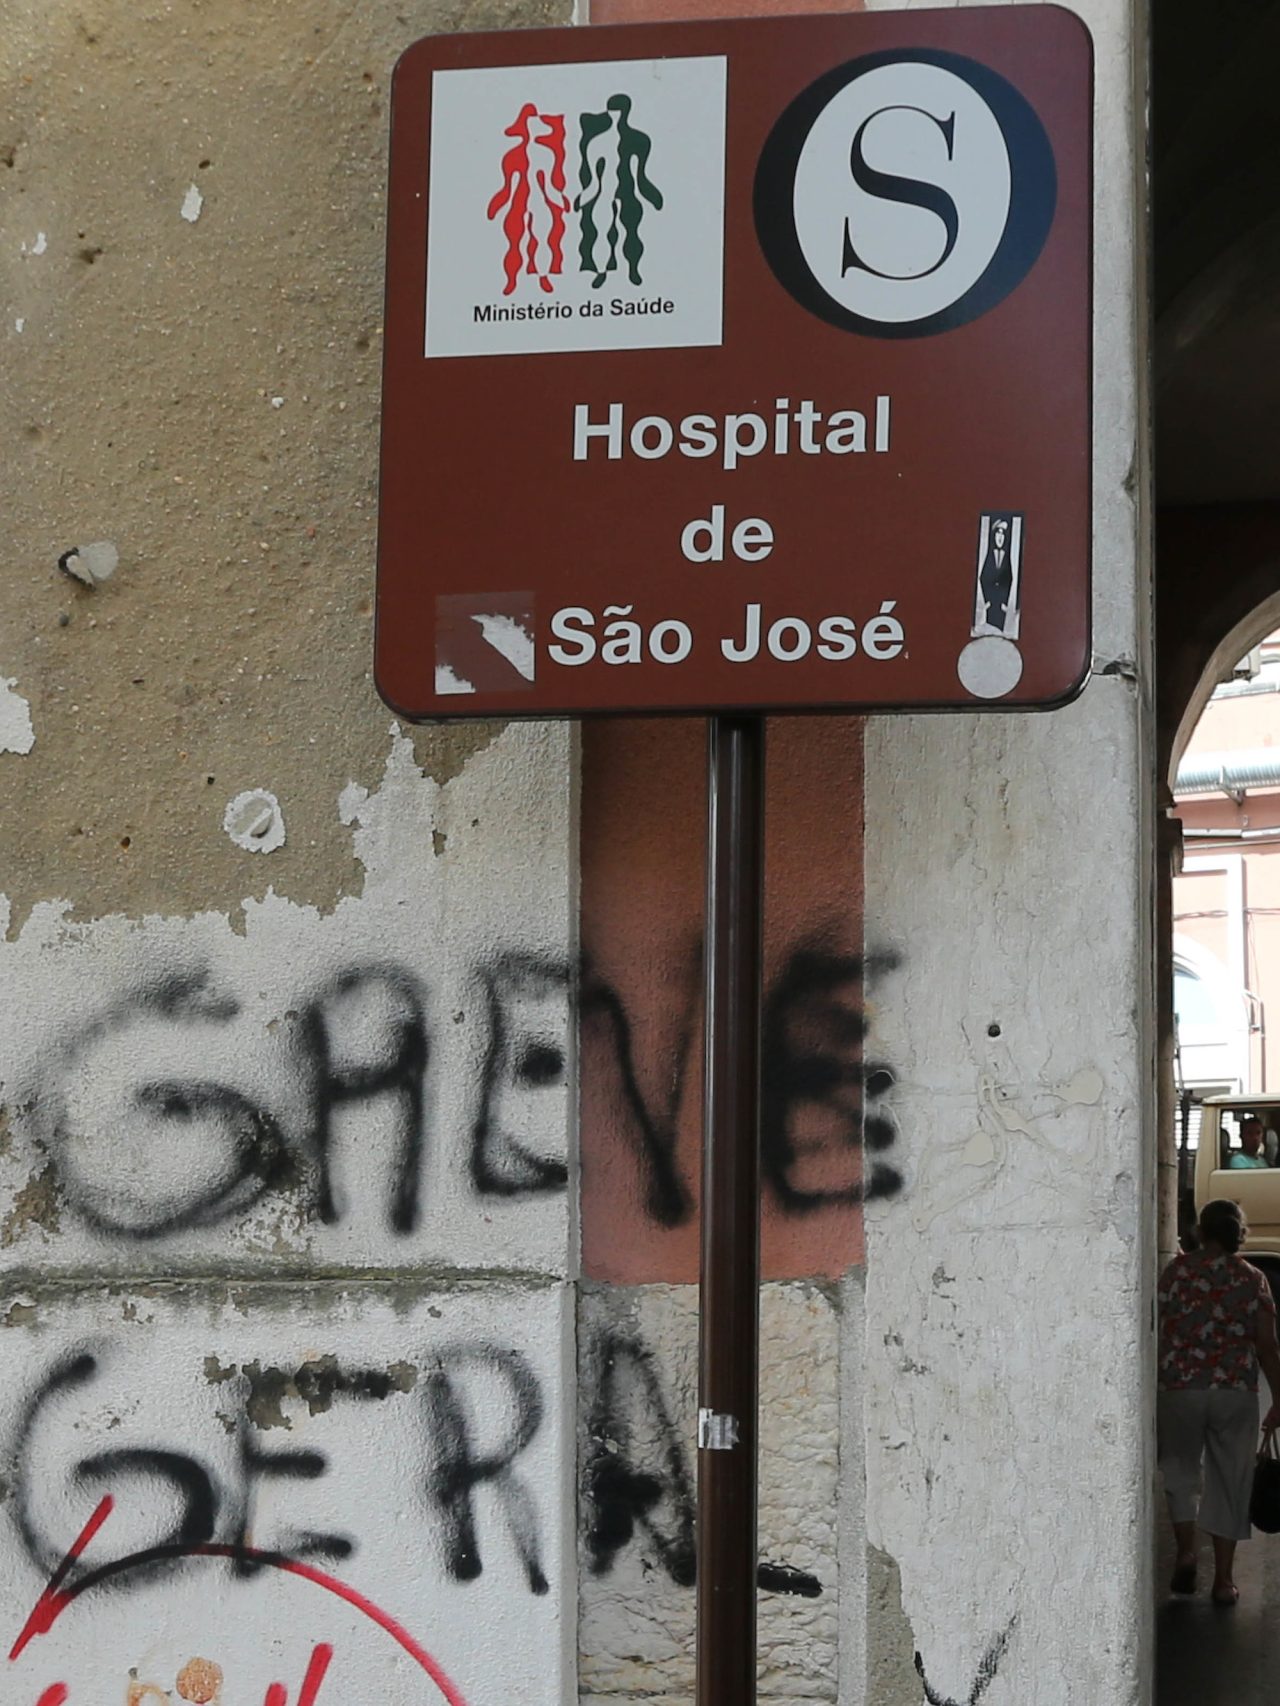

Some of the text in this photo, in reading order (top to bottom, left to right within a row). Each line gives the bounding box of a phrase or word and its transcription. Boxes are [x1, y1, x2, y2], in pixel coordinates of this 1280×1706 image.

[841, 104, 959, 280] S
[474, 296, 675, 323] Ministério da Saúde
[573, 395, 890, 470] Hospital
[681, 504, 774, 563] de
[548, 600, 904, 666] São José
